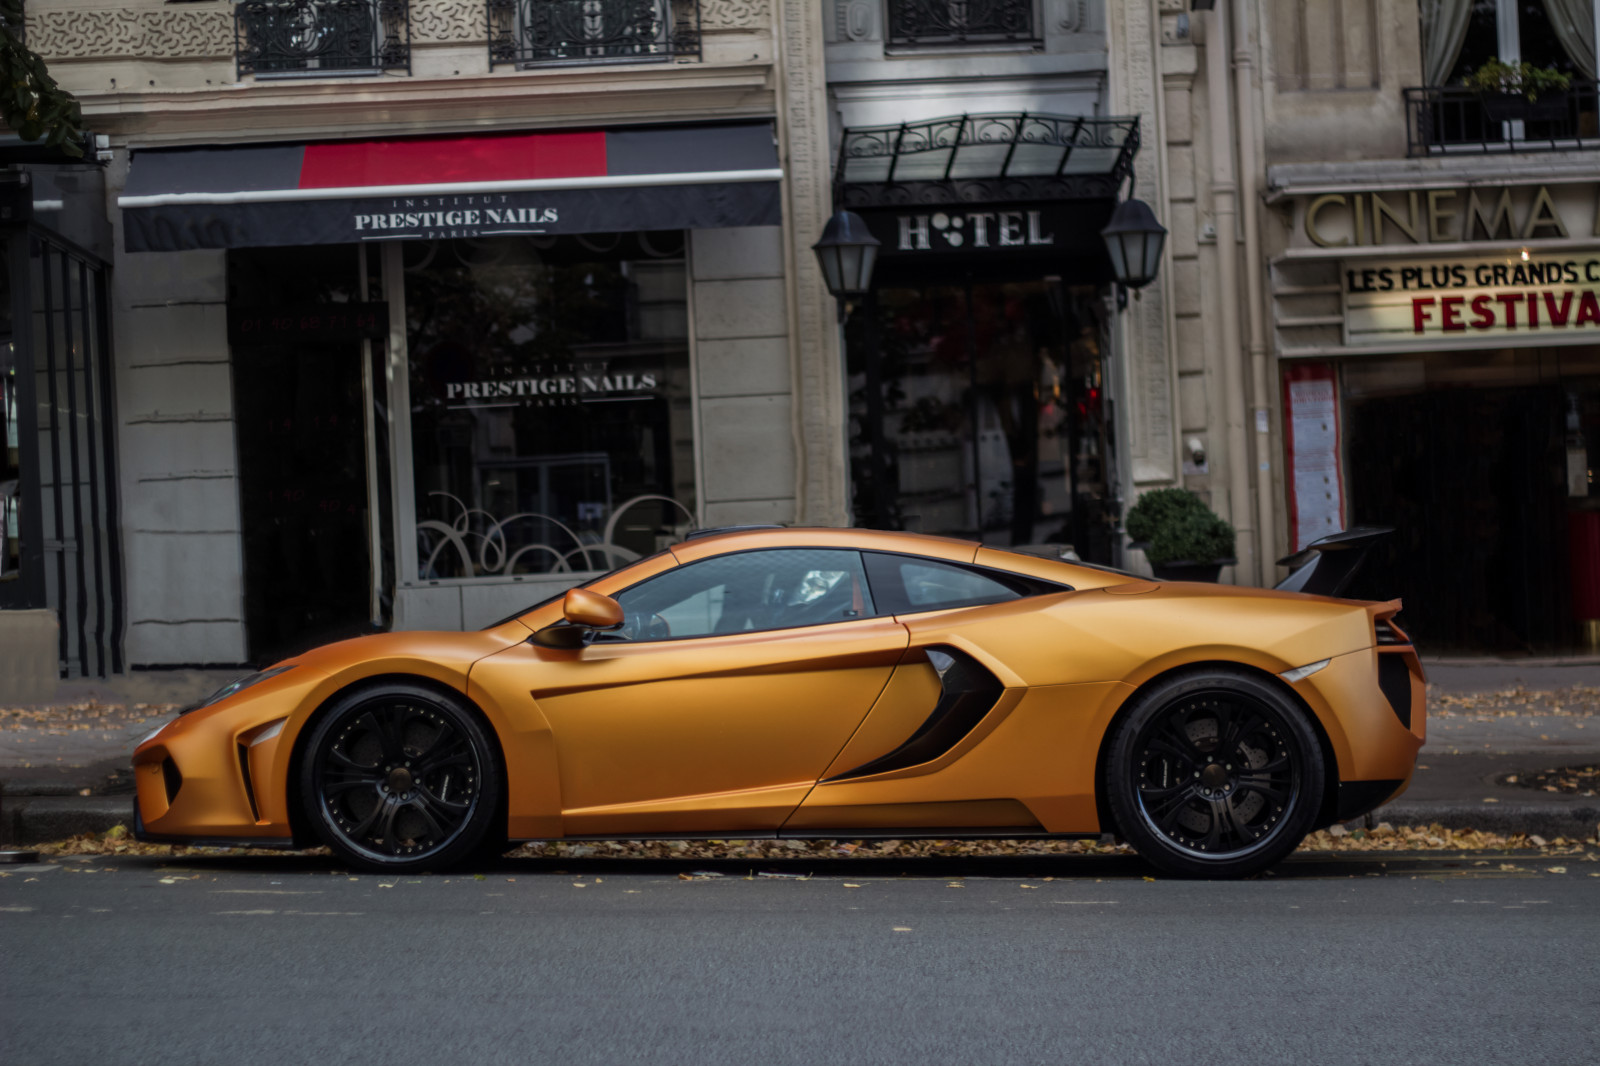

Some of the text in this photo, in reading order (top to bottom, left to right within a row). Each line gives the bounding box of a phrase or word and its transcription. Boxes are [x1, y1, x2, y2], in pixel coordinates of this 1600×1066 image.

[393, 195, 508, 208] INSTITUT
[354, 207, 559, 230] PRESTIGE NAILS
[1305, 186, 1570, 249] CINEMA
[428, 229, 478, 240] PARIS
[1347, 267, 1394, 293] LES
[1402, 264, 1467, 290] PLUS
[1475, 260, 1579, 287] GRANDS
[1412, 290, 1600, 335] FESTIVA
[490, 361, 609, 376] INSTITUT
[446, 373, 657, 399] PRESTIGE NAILS
[525, 397, 578, 408] PARIS
